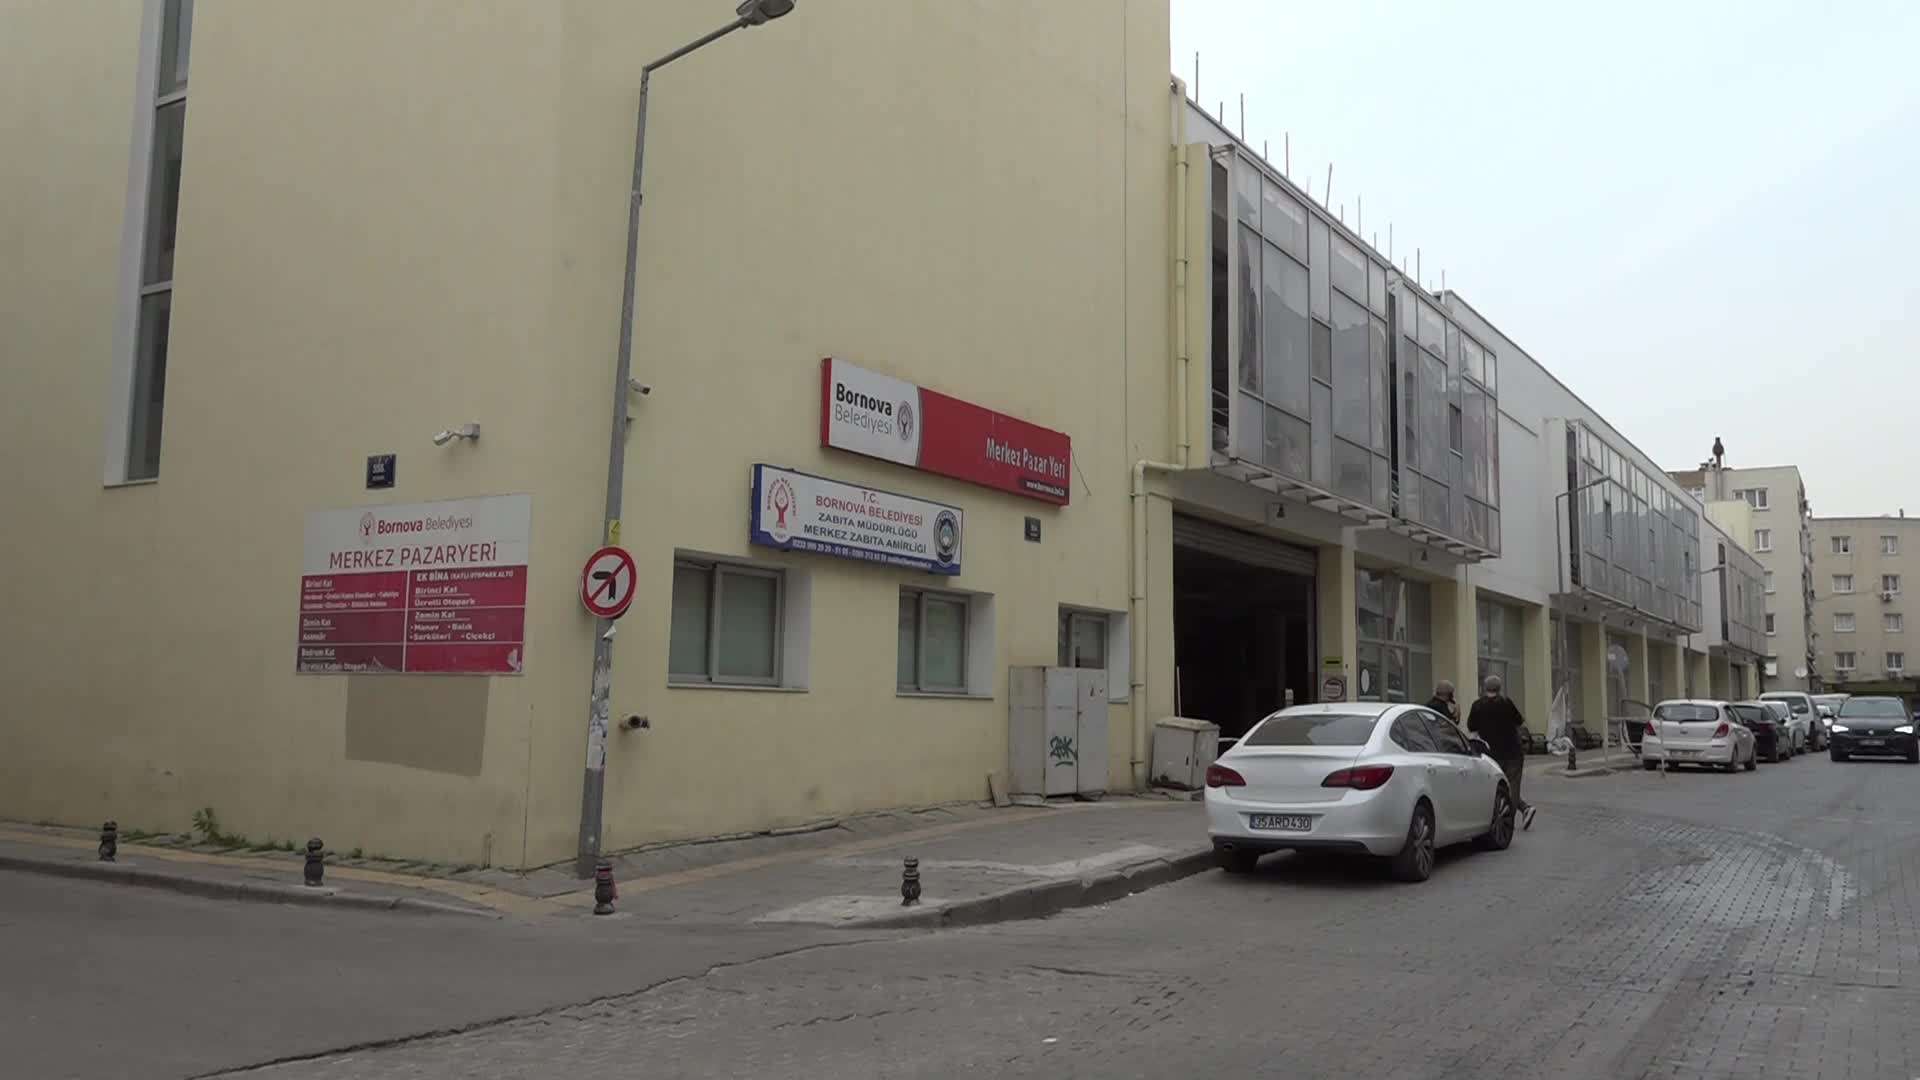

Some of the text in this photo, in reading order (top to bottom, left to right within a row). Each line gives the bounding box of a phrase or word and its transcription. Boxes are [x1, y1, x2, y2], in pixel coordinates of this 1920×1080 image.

[836, 383, 892, 416] Bornova
[835, 403, 892, 436] Belediyesi
[986, 437, 1066, 479] Merkez Pazar Yeri
[815, 495, 866, 516] BORNOVA
[868, 505, 924, 527] BELEDİYESİ
[862, 491, 880, 504] T.C.
[377, 515, 472, 535] Bornova Belediyesi
[803, 523, 848, 540] MERKEZ
[849, 531, 884, 547] ZABITA
[886, 538, 927, 554] AMİRLİĞİ
[818, 512, 918, 539] ZABITA MÜDÜRLÜĞÜ
[329, 541, 497, 569] MERKEZ PAZARYERİ
[416, 573, 428, 582] EK
[429, 570, 449, 582] BİNA
[442, 598, 476, 607] Otopark
[443, 586, 458, 594] Kat
[415, 611, 456, 619] Zemin Kat
